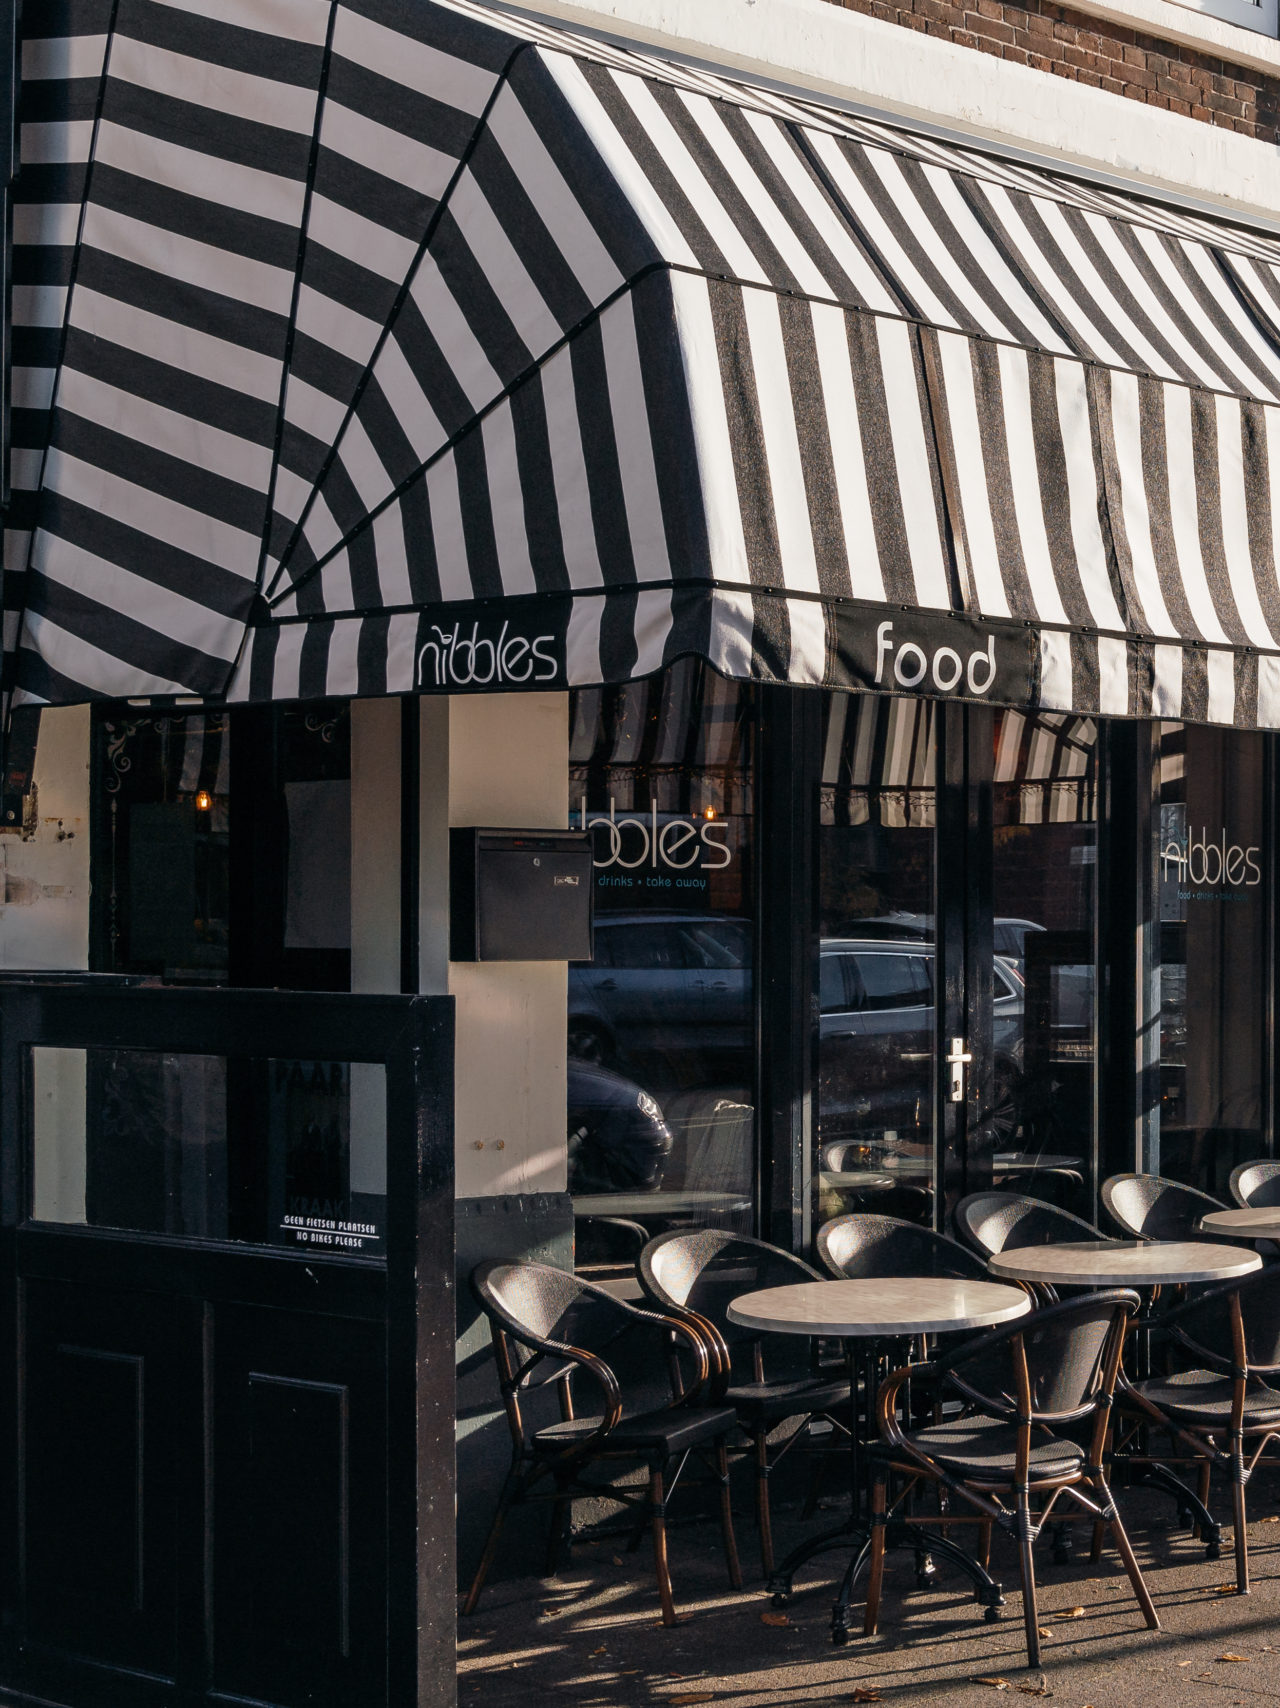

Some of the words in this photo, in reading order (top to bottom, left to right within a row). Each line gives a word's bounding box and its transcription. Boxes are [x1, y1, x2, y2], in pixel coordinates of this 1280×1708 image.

[416, 620, 559, 686] nibbles
[875, 620, 997, 695] food
[571, 795, 732, 869] bbles
[1163, 825, 1262, 886] nibbles
[598, 875, 633, 887] drinks
[646, 875, 672, 888] take
[675, 878, 706, 891] away
[1177, 889, 1191, 900] food
[283, 1214, 304, 1226] GEEN
[306, 1217, 336, 1230] FIETSEN
[338, 1221, 376, 1235] PLAATSEN
[296, 1231, 308, 1241] NO
[310, 1233, 333, 1245] BIKES
[335, 1235, 363, 1248] PLEASE
